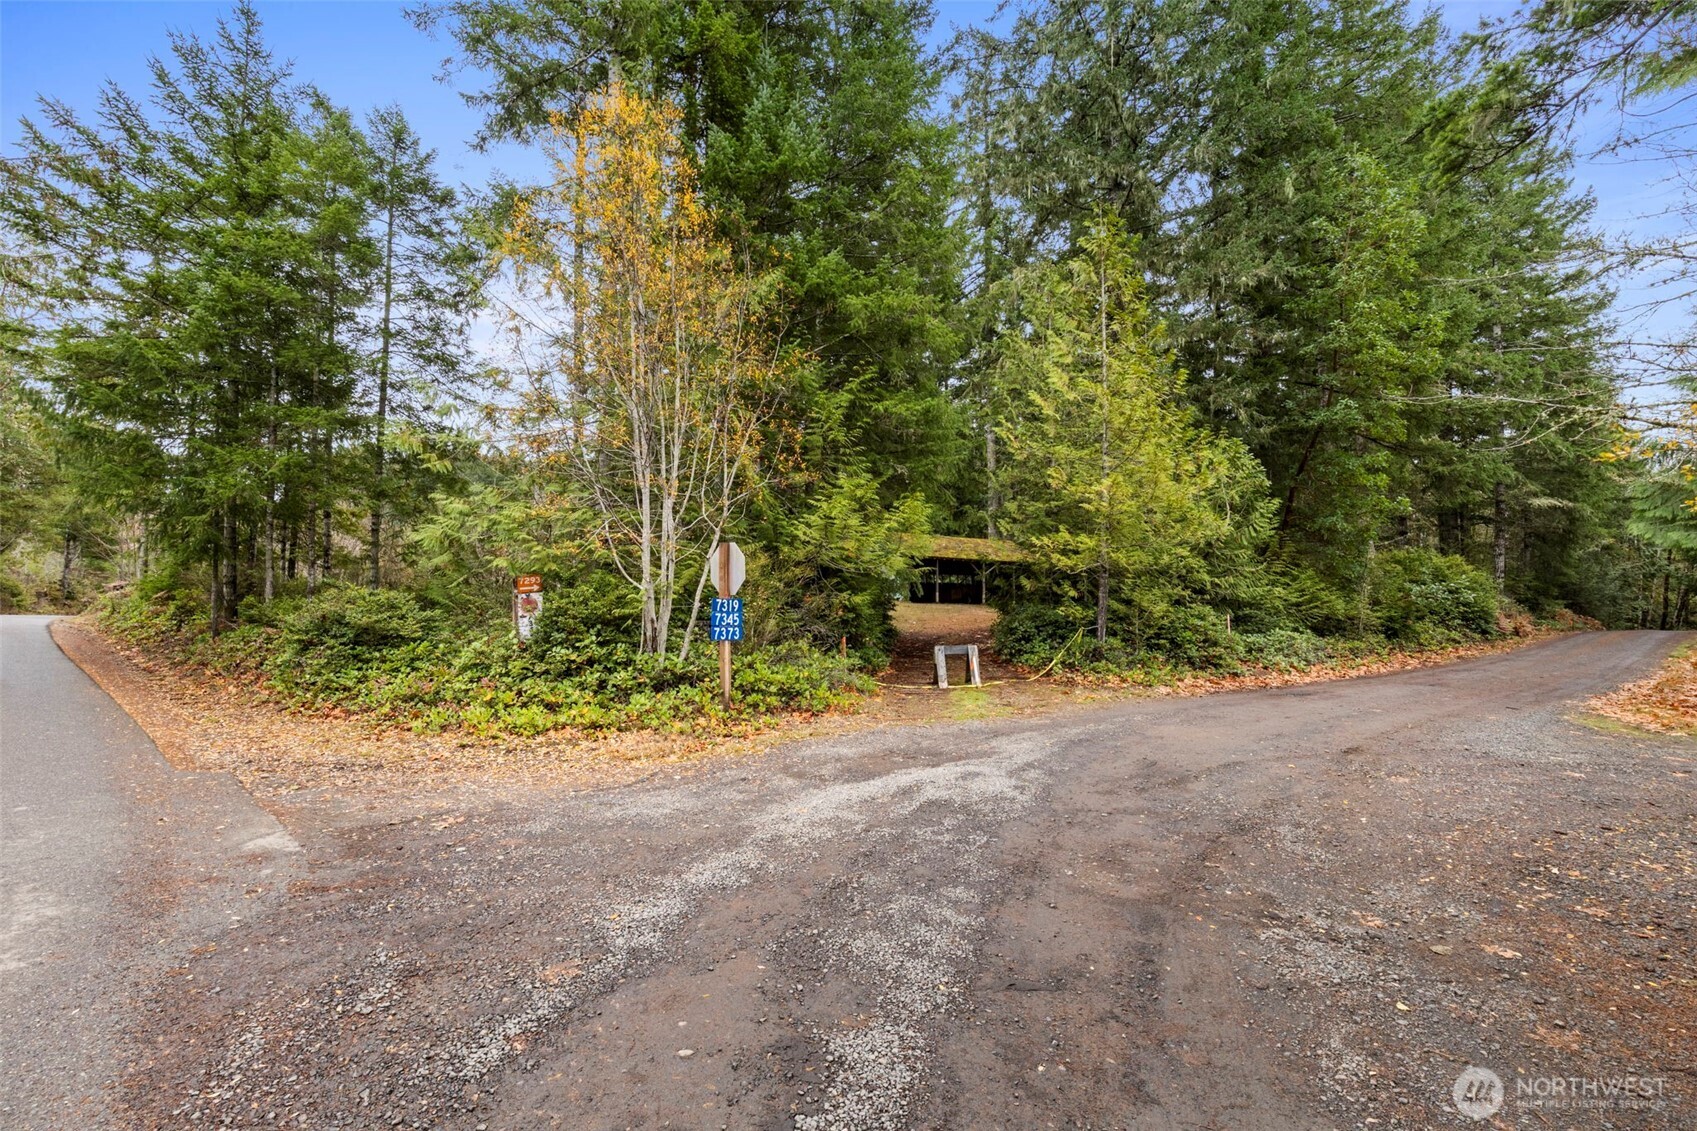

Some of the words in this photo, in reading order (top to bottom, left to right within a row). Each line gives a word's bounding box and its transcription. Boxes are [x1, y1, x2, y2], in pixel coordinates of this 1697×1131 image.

[519, 577, 541, 585] 7293
[716, 599, 739, 612] 7319
[715, 613, 740, 626] 7345
[714, 627, 740, 640] 7373
